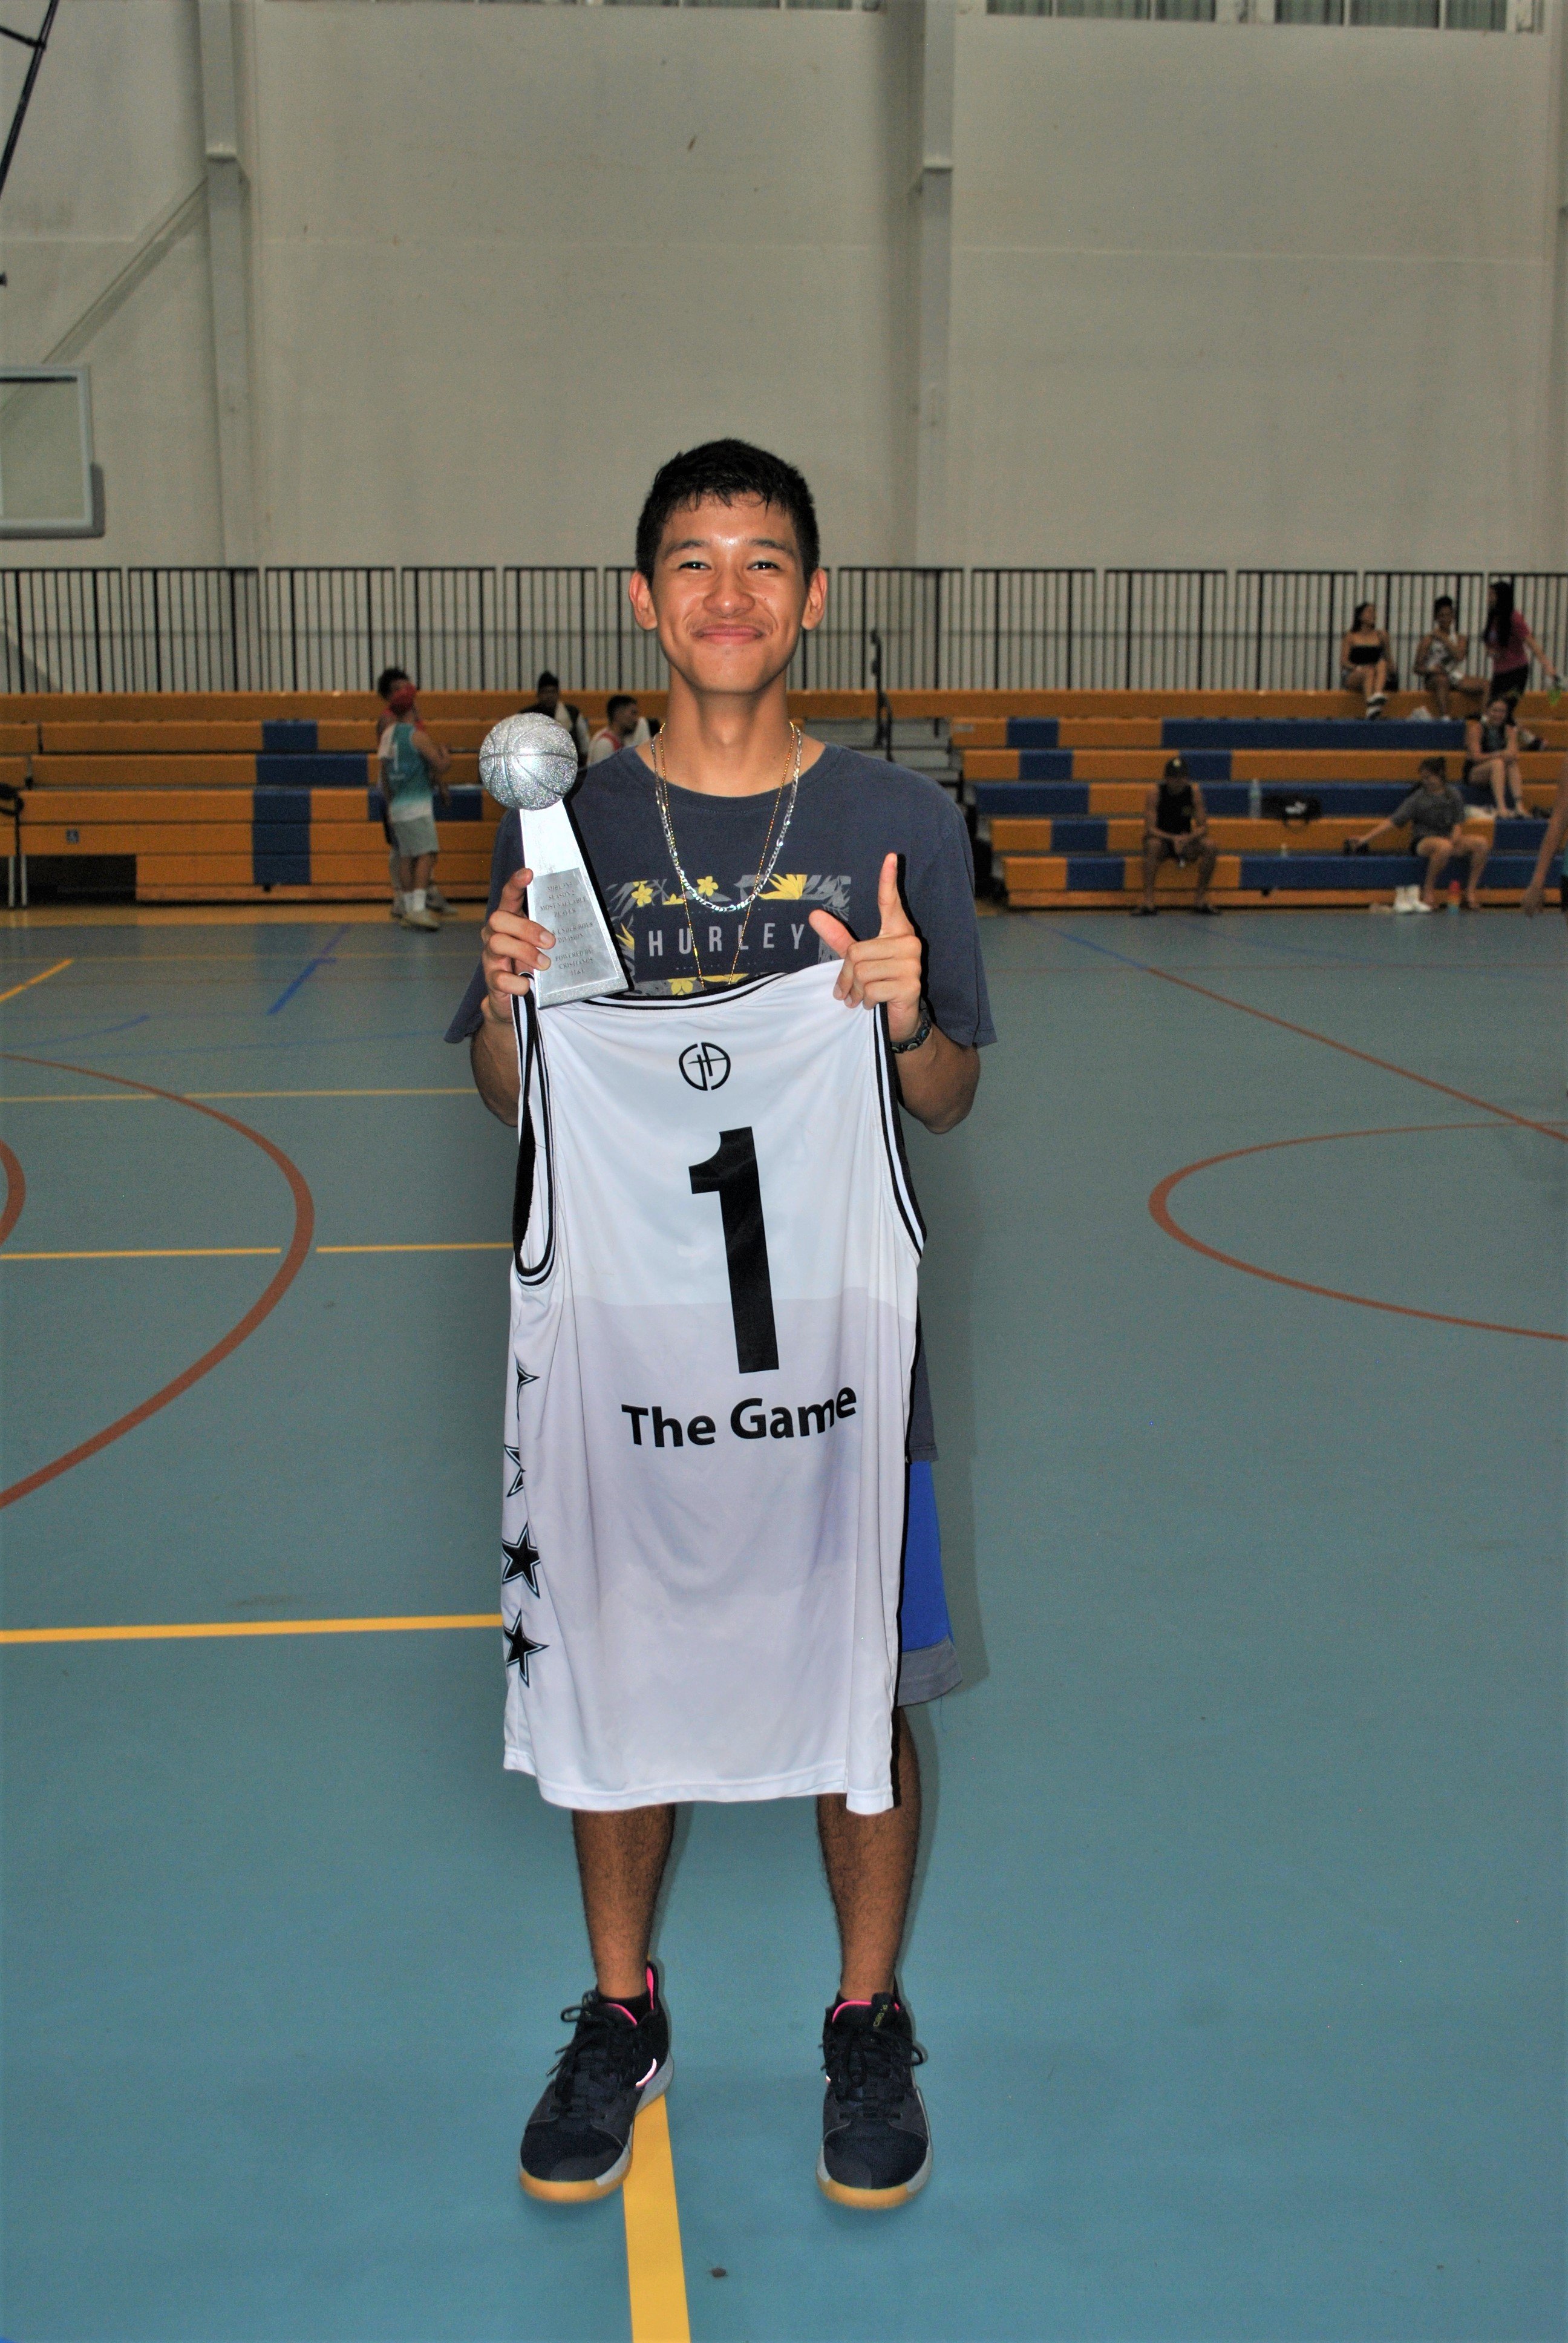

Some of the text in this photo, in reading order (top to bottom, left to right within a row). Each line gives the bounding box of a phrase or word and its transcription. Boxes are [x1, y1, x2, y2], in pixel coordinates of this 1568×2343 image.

[548, 891, 570, 900] SEASON
[557, 896, 587, 906] VALUABLE
[554, 909, 577, 917] PLAYER
[557, 925, 577, 934] UNDER
[558, 932, 584, 943] DIVISION
[648, 923, 805, 957] HURLEY
[555, 950, 584, 962] POWERED
[688, 1126, 779, 1374] 1
[621, 1386, 857, 1447] The Game
